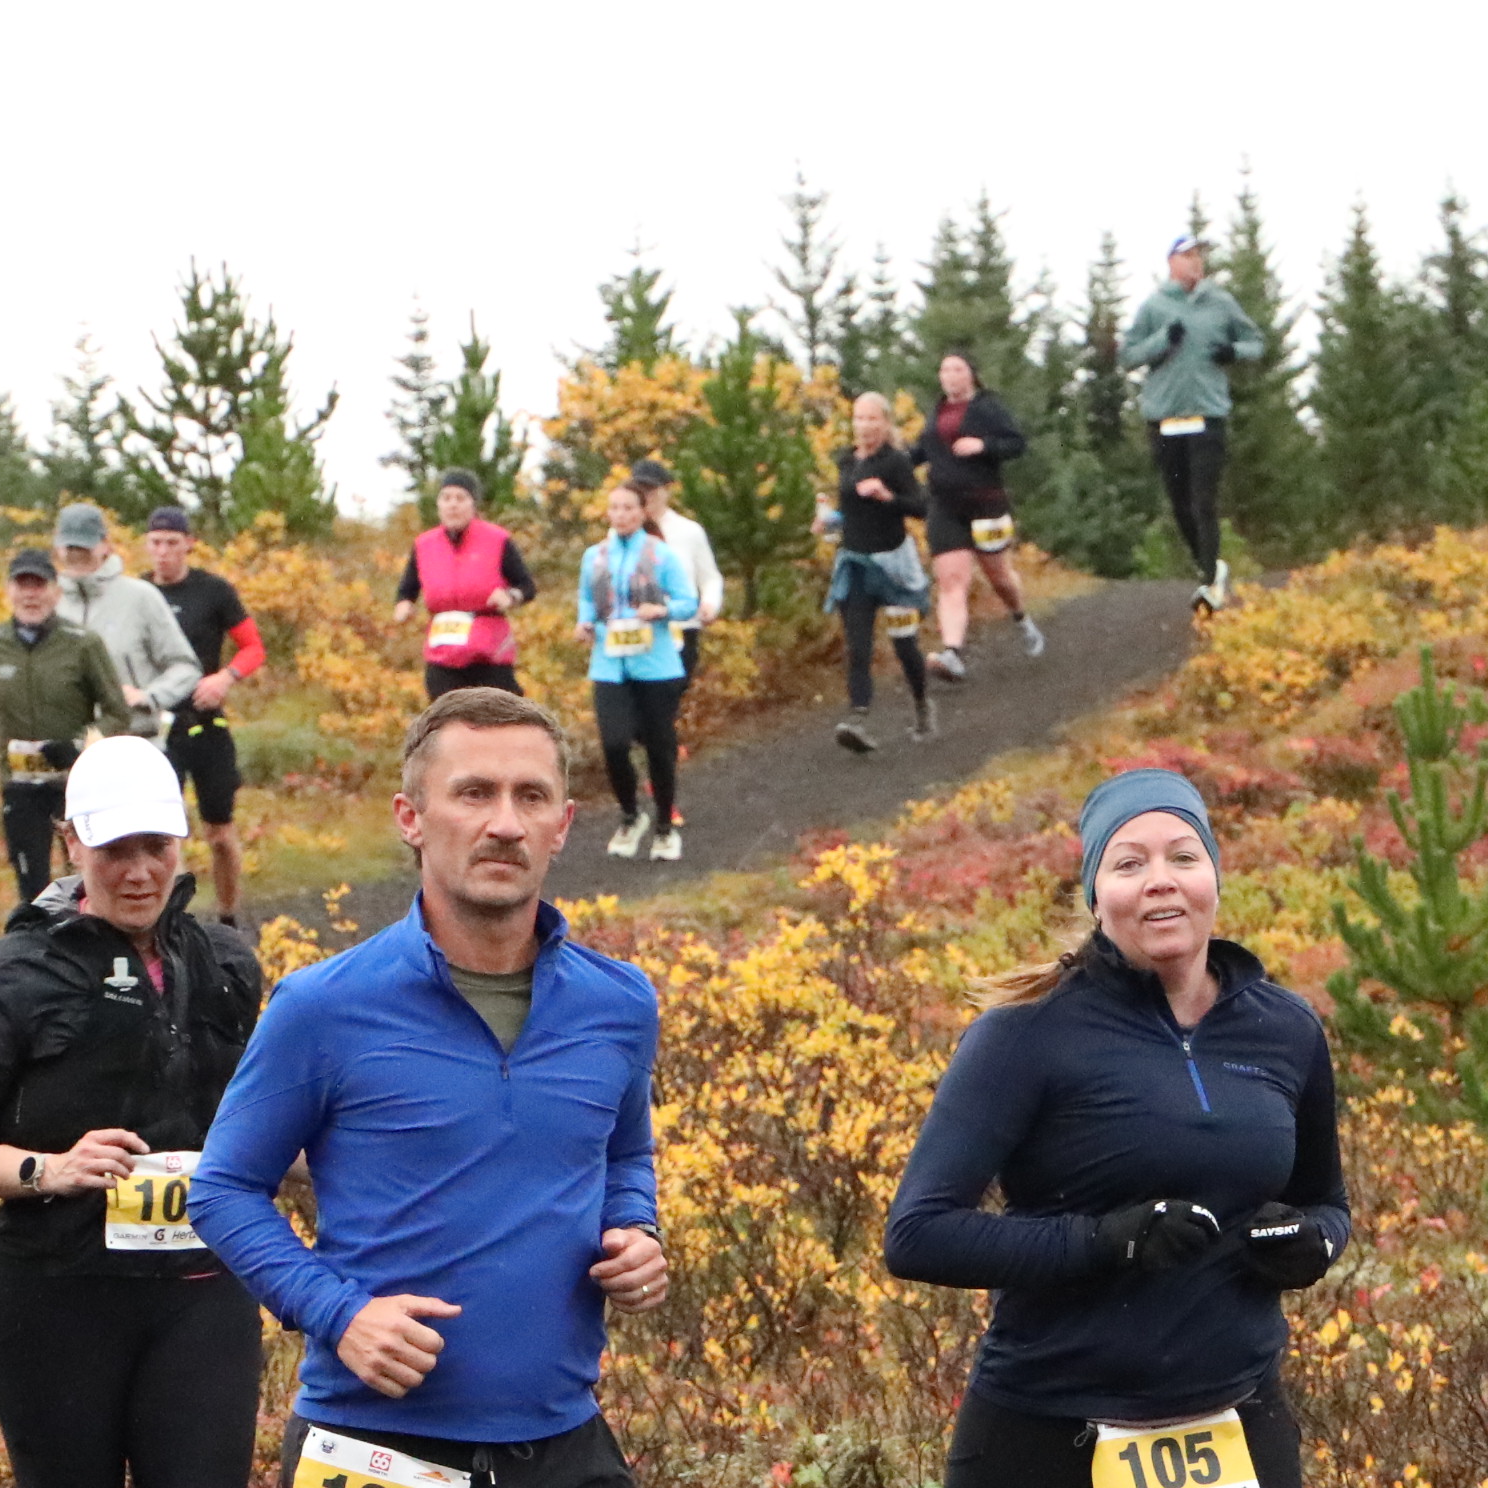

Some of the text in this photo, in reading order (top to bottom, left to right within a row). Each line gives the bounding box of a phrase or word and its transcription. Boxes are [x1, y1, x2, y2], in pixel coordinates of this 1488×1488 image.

[1223, 1061, 1260, 1075] CRAFT
[135, 1178, 188, 1223] 10
[1250, 1223, 1300, 1238] SAYSKY
[371, 1451, 391, 1470] 66
